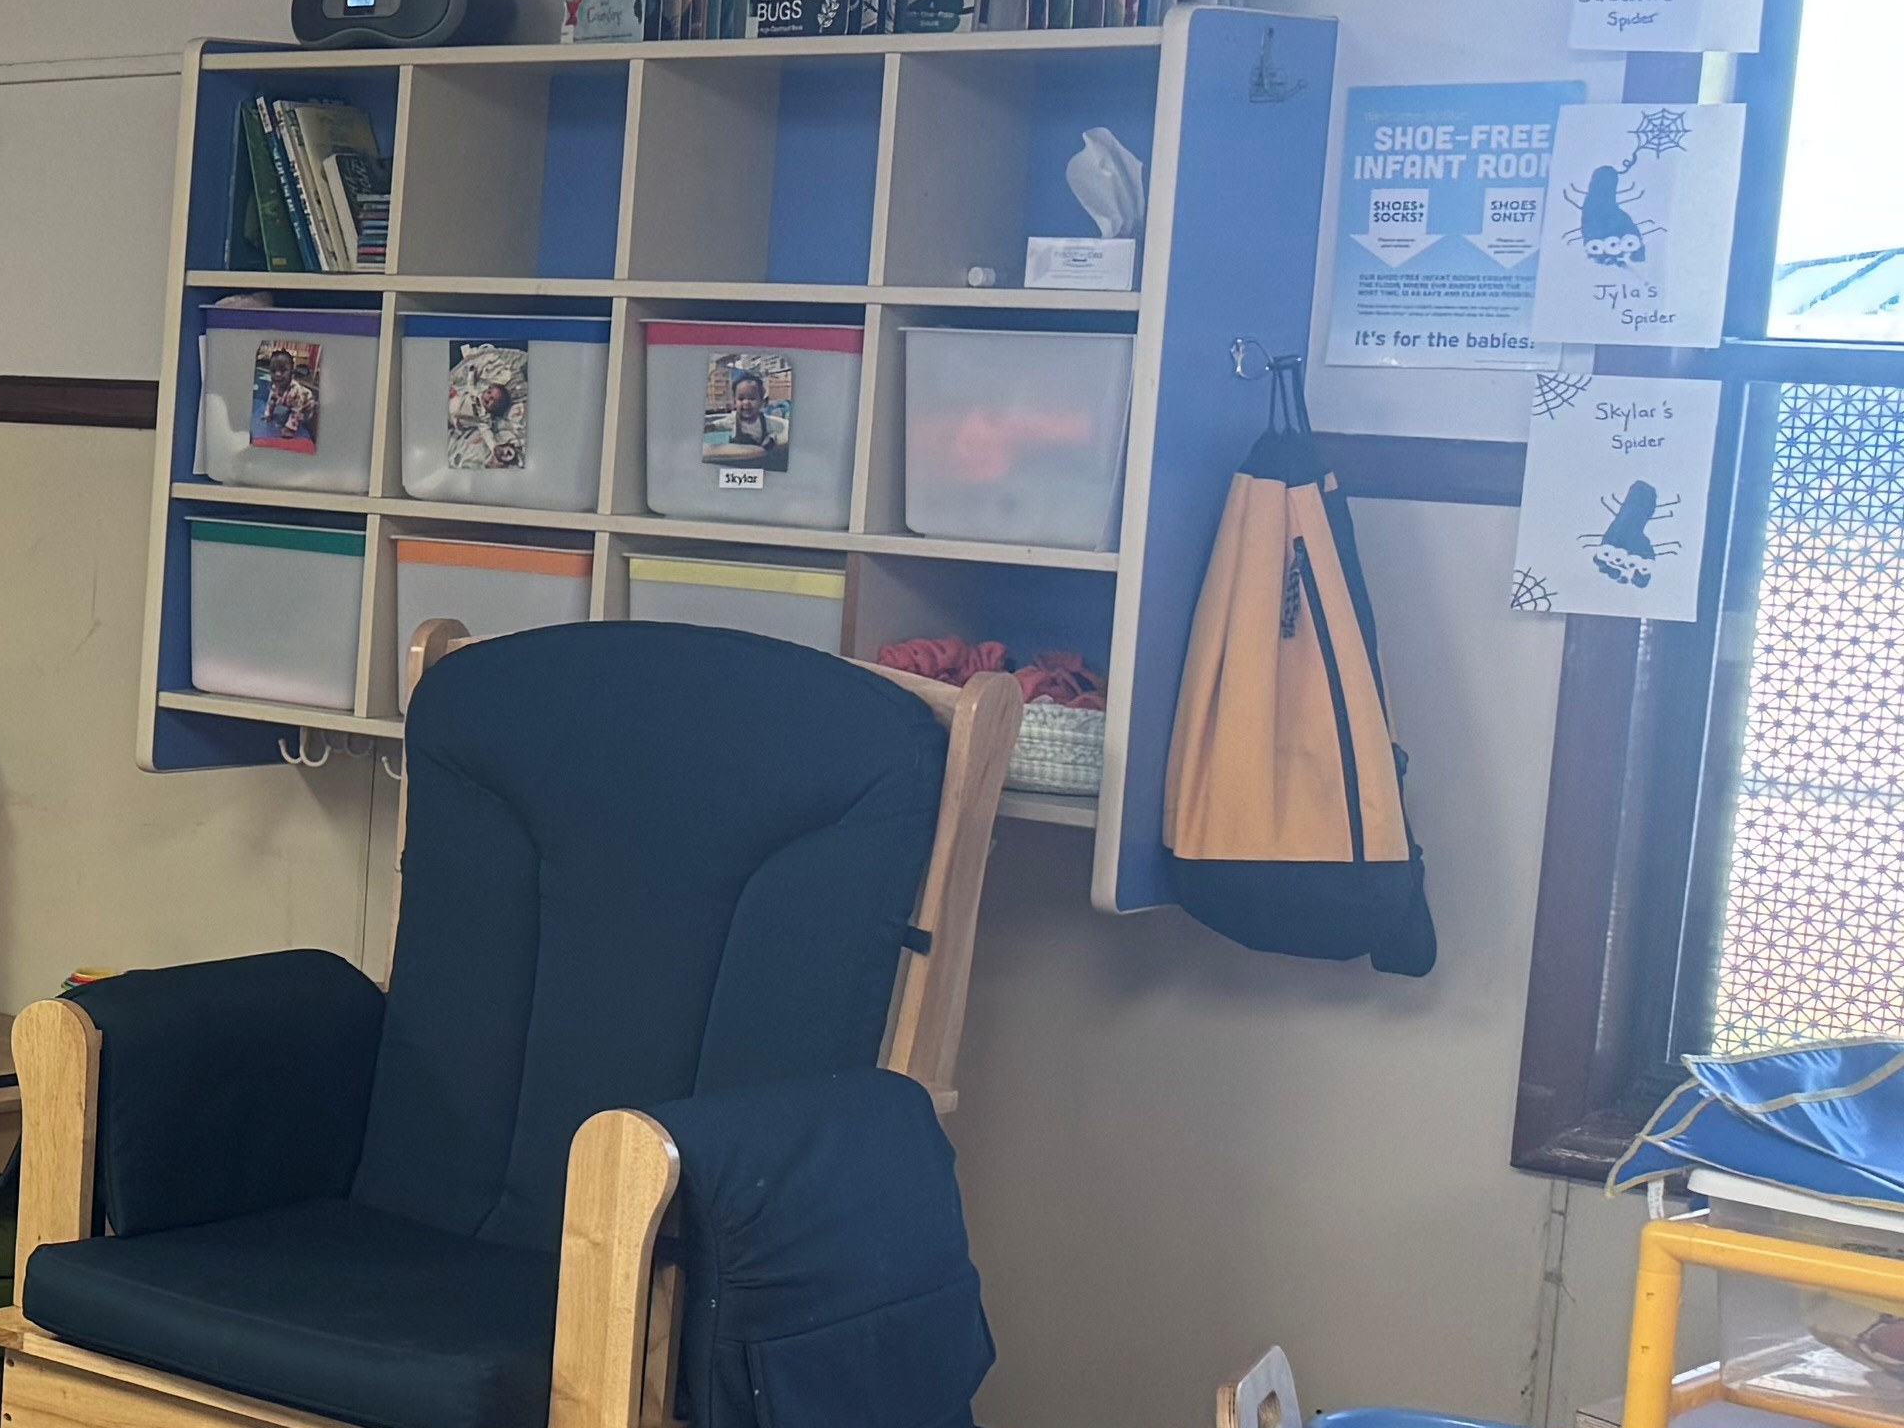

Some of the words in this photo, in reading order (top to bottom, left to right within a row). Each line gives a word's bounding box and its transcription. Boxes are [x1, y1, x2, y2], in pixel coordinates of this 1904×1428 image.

[757, 0, 802, 21] BUGS
[1606, 11, 1659, 32] Spider
[1374, 124, 1551, 151] SHOE-FREE
[1354, 154, 1466, 179] INFANT
[1490, 200, 1536, 210] SHOES
[1373, 212, 1423, 222] SOCKS?
[1492, 212, 1535, 222] ONLY?
[1593, 282, 1658, 309] Jyla's
[1620, 309, 1676, 331] Spider
[1355, 330, 1386, 346] It's
[1393, 330, 1420, 347] for
[1428, 332, 1459, 348] the
[1595, 400, 1674, 432] Skylar's
[1611, 435, 1665, 454] Spider
[725, 473, 758, 486] Skylar
